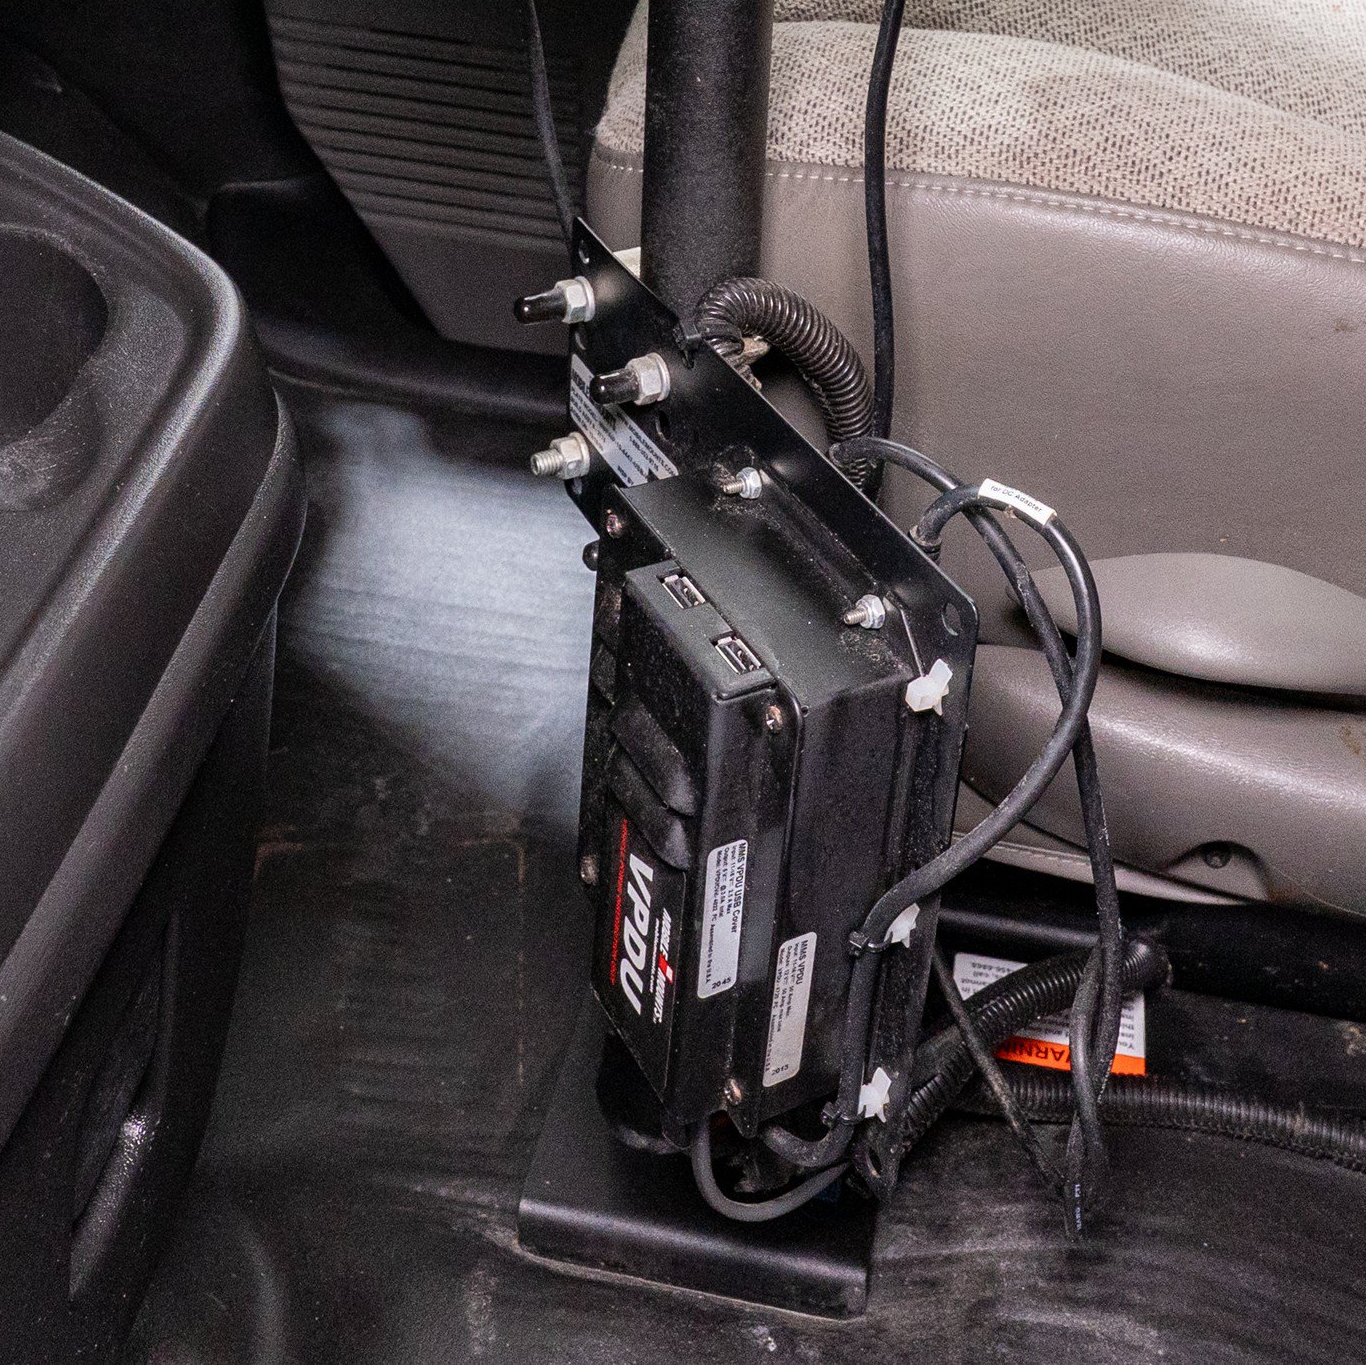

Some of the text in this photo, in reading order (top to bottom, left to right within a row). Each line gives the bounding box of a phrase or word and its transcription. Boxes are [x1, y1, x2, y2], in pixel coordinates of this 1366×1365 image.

[1001, 489, 1015, 497] DC
[1014, 494, 1043, 513] Adapter
[730, 841, 746, 934] MMS VPDU USB Cover
[620, 853, 654, 1016] VPDU
[654, 908, 672, 1021] MOBILE MOUNTS
[795, 938, 808, 985] MMS VPDU
